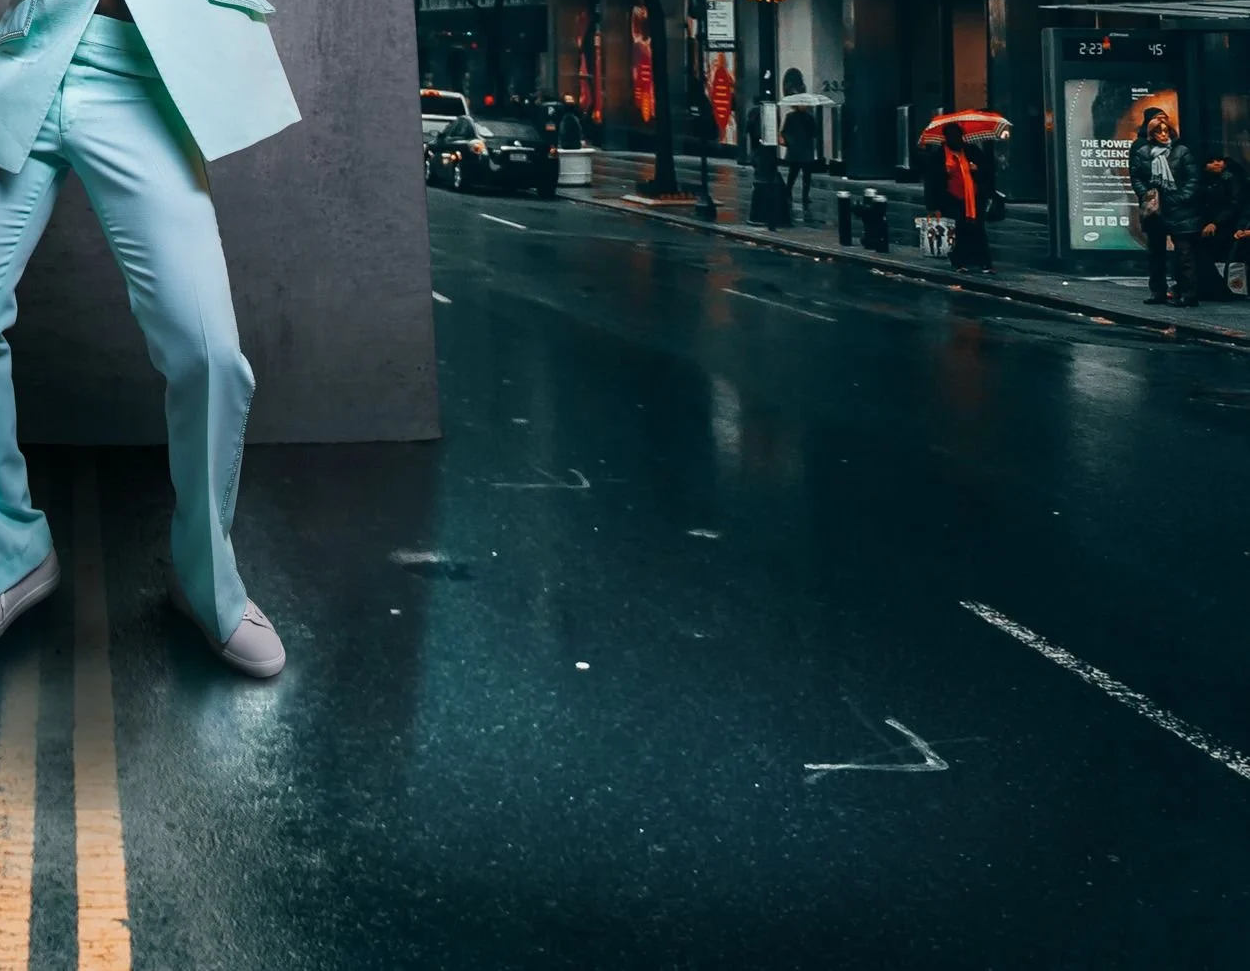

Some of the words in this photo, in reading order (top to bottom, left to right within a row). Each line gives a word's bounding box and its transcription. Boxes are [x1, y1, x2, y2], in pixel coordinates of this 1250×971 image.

[1080, 139, 1099, 148] THE
[1080, 149, 1093, 158] OF
[1095, 149, 1130, 158] SCIENC
